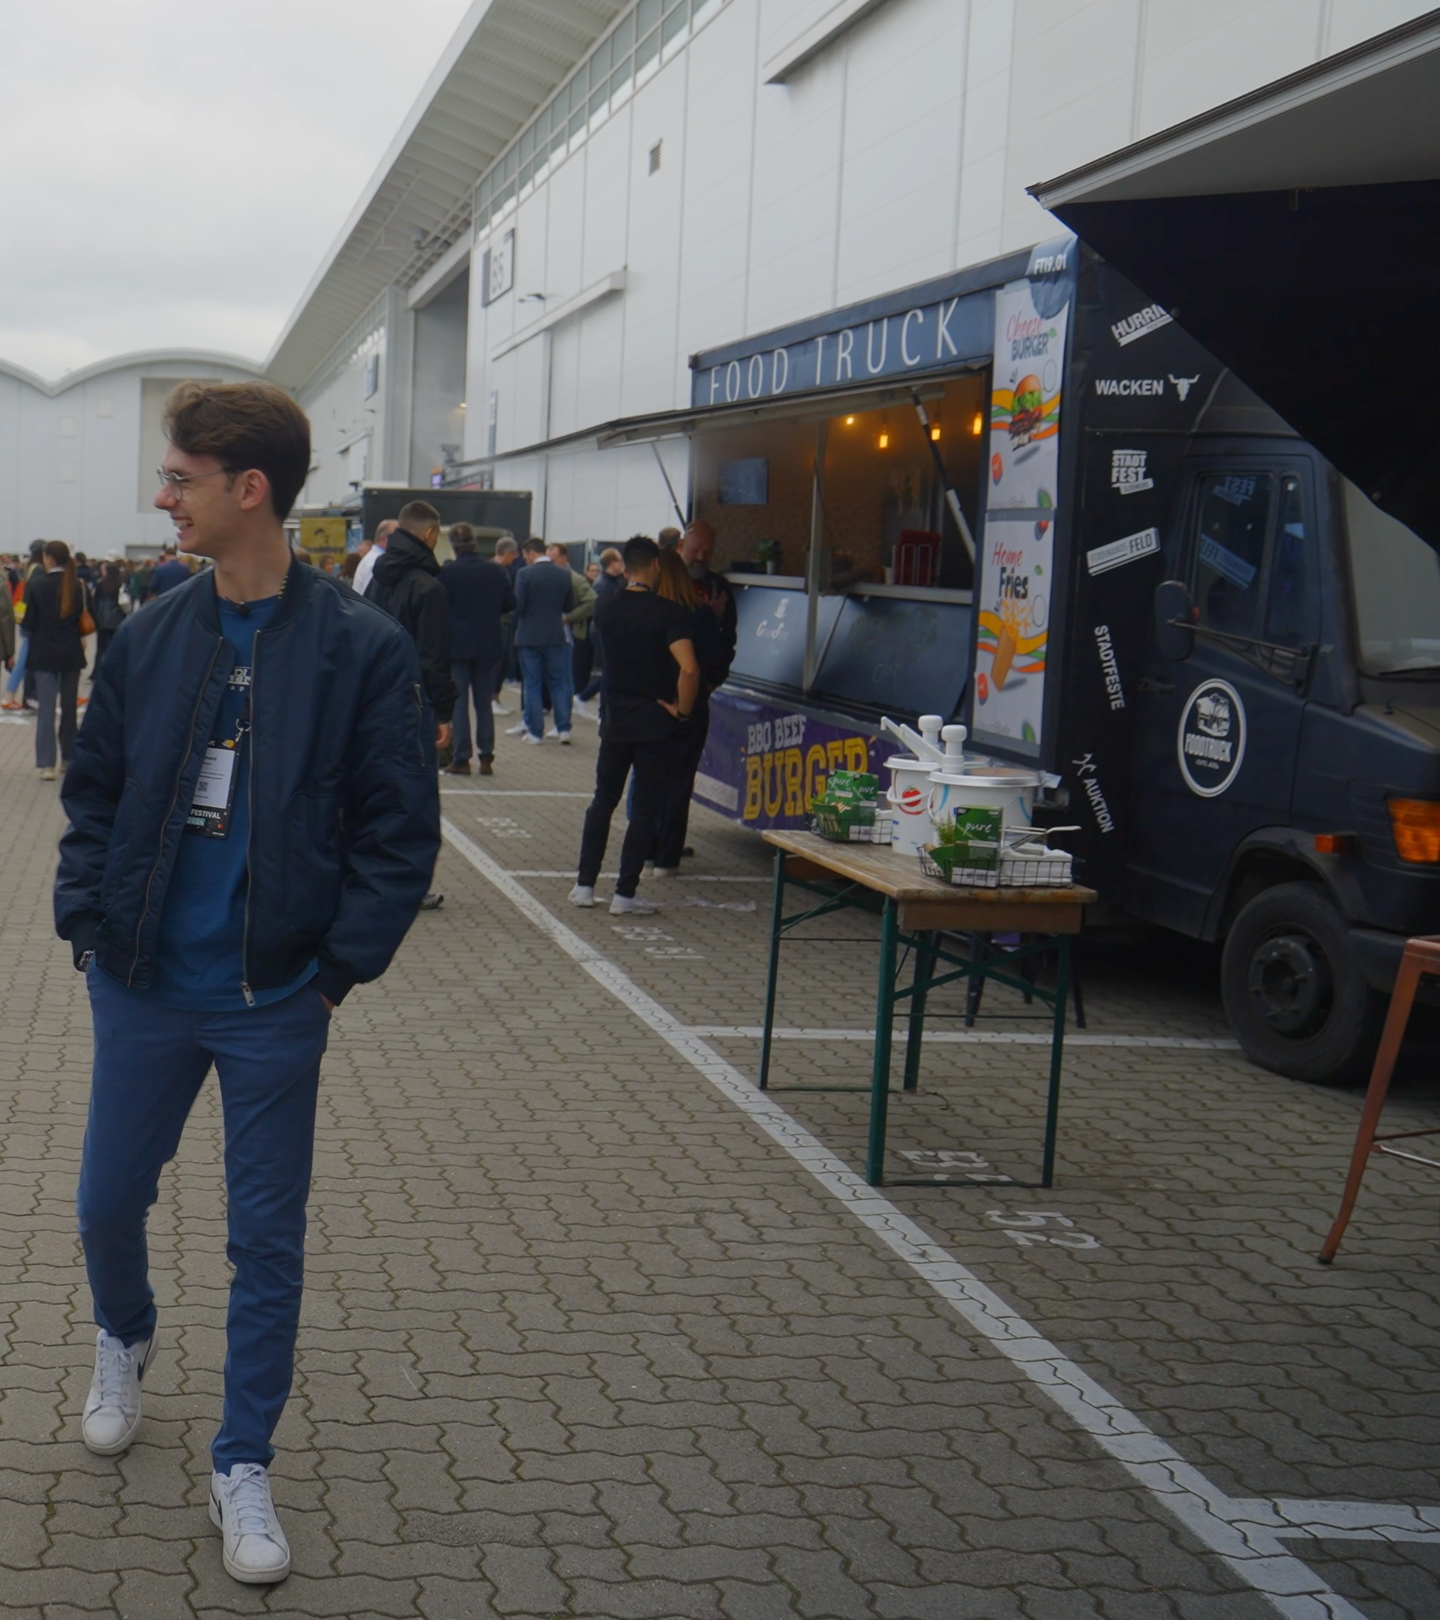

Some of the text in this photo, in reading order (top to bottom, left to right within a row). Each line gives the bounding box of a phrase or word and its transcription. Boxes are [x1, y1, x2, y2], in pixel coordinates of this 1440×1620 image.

[1006, 310, 1044, 343] Cheese
[709, 297, 960, 405] FOOD TRUCK
[1011, 333, 1050, 362] BURGER
[1095, 379, 1164, 396] WACKEN
[1111, 467, 1147, 483] FEST
[1112, 454, 1147, 467] STADT
[992, 542, 1023, 567] Home
[998, 567, 1029, 599] Fries
[1094, 625, 1125, 711] STADTFESTE
[747, 713, 807, 755] BBQ BEEF
[1184, 732, 1233, 763] FOODTRUCK
[832, 777, 851, 788] pure
[190, 808, 221, 819] FESTIVAL
[1083, 777, 1115, 834] AUKTION
[964, 821, 993, 834] pure
